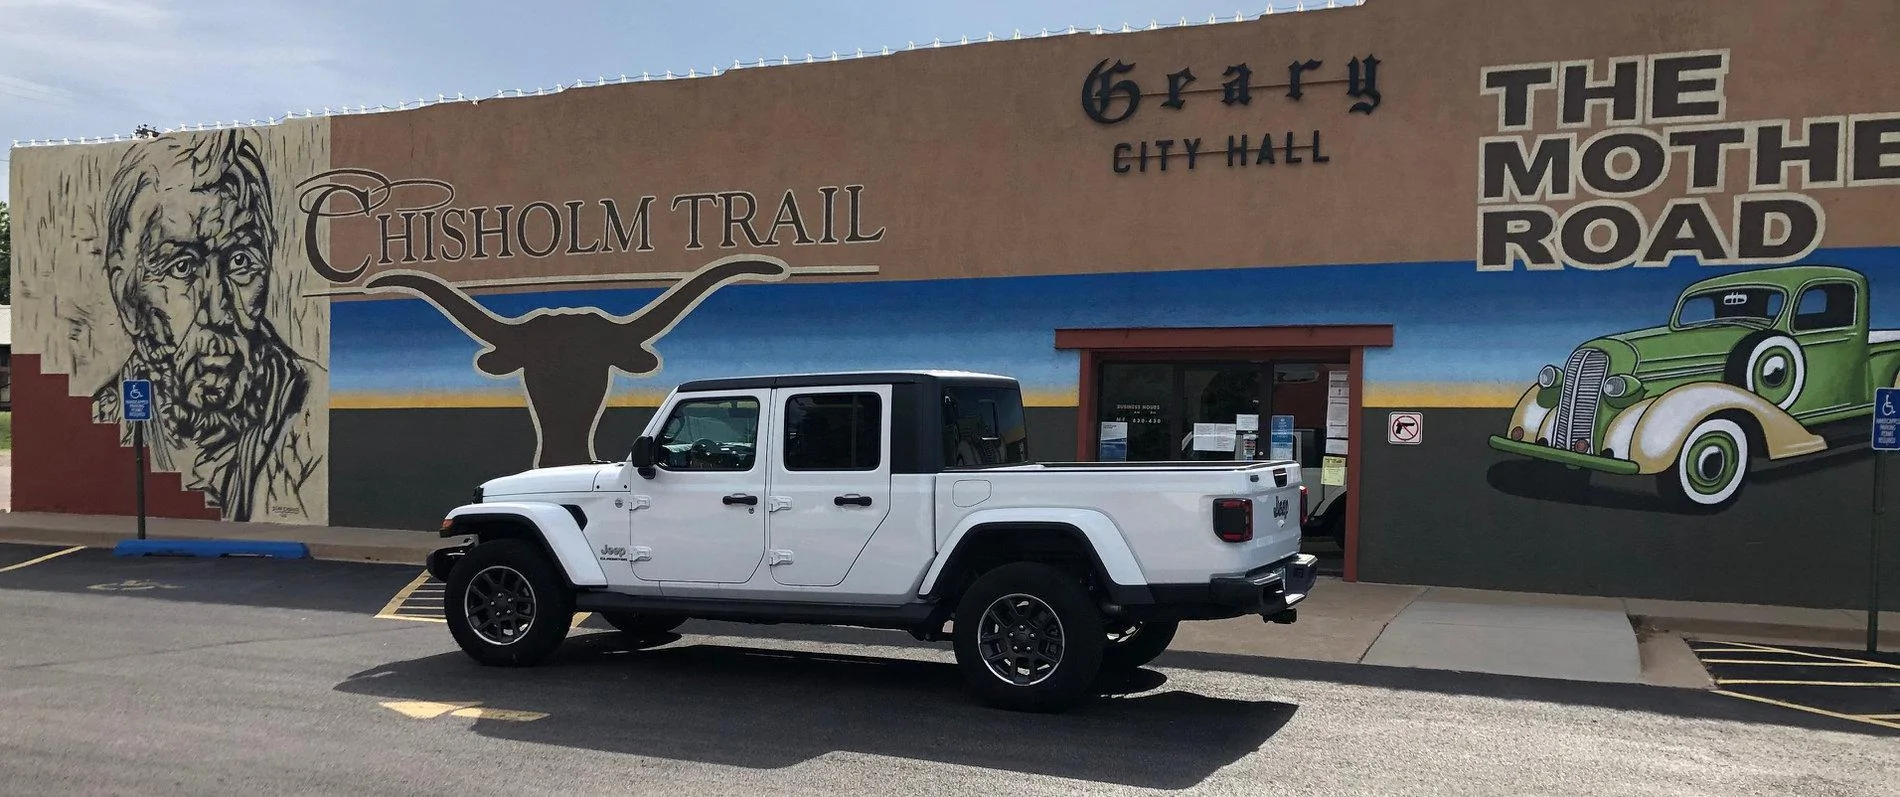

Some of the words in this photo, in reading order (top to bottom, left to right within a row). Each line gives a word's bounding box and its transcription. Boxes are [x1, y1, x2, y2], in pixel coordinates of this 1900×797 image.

[1082, 54, 1381, 124] Geary
[1481, 48, 1730, 131] THE
[1113, 137, 1201, 173] CITY
[1227, 130, 1330, 166] HALL
[671, 184, 886, 249] TRAIL
[1476, 192, 1825, 271] ROAD
[601, 544, 627, 557] Jeep
